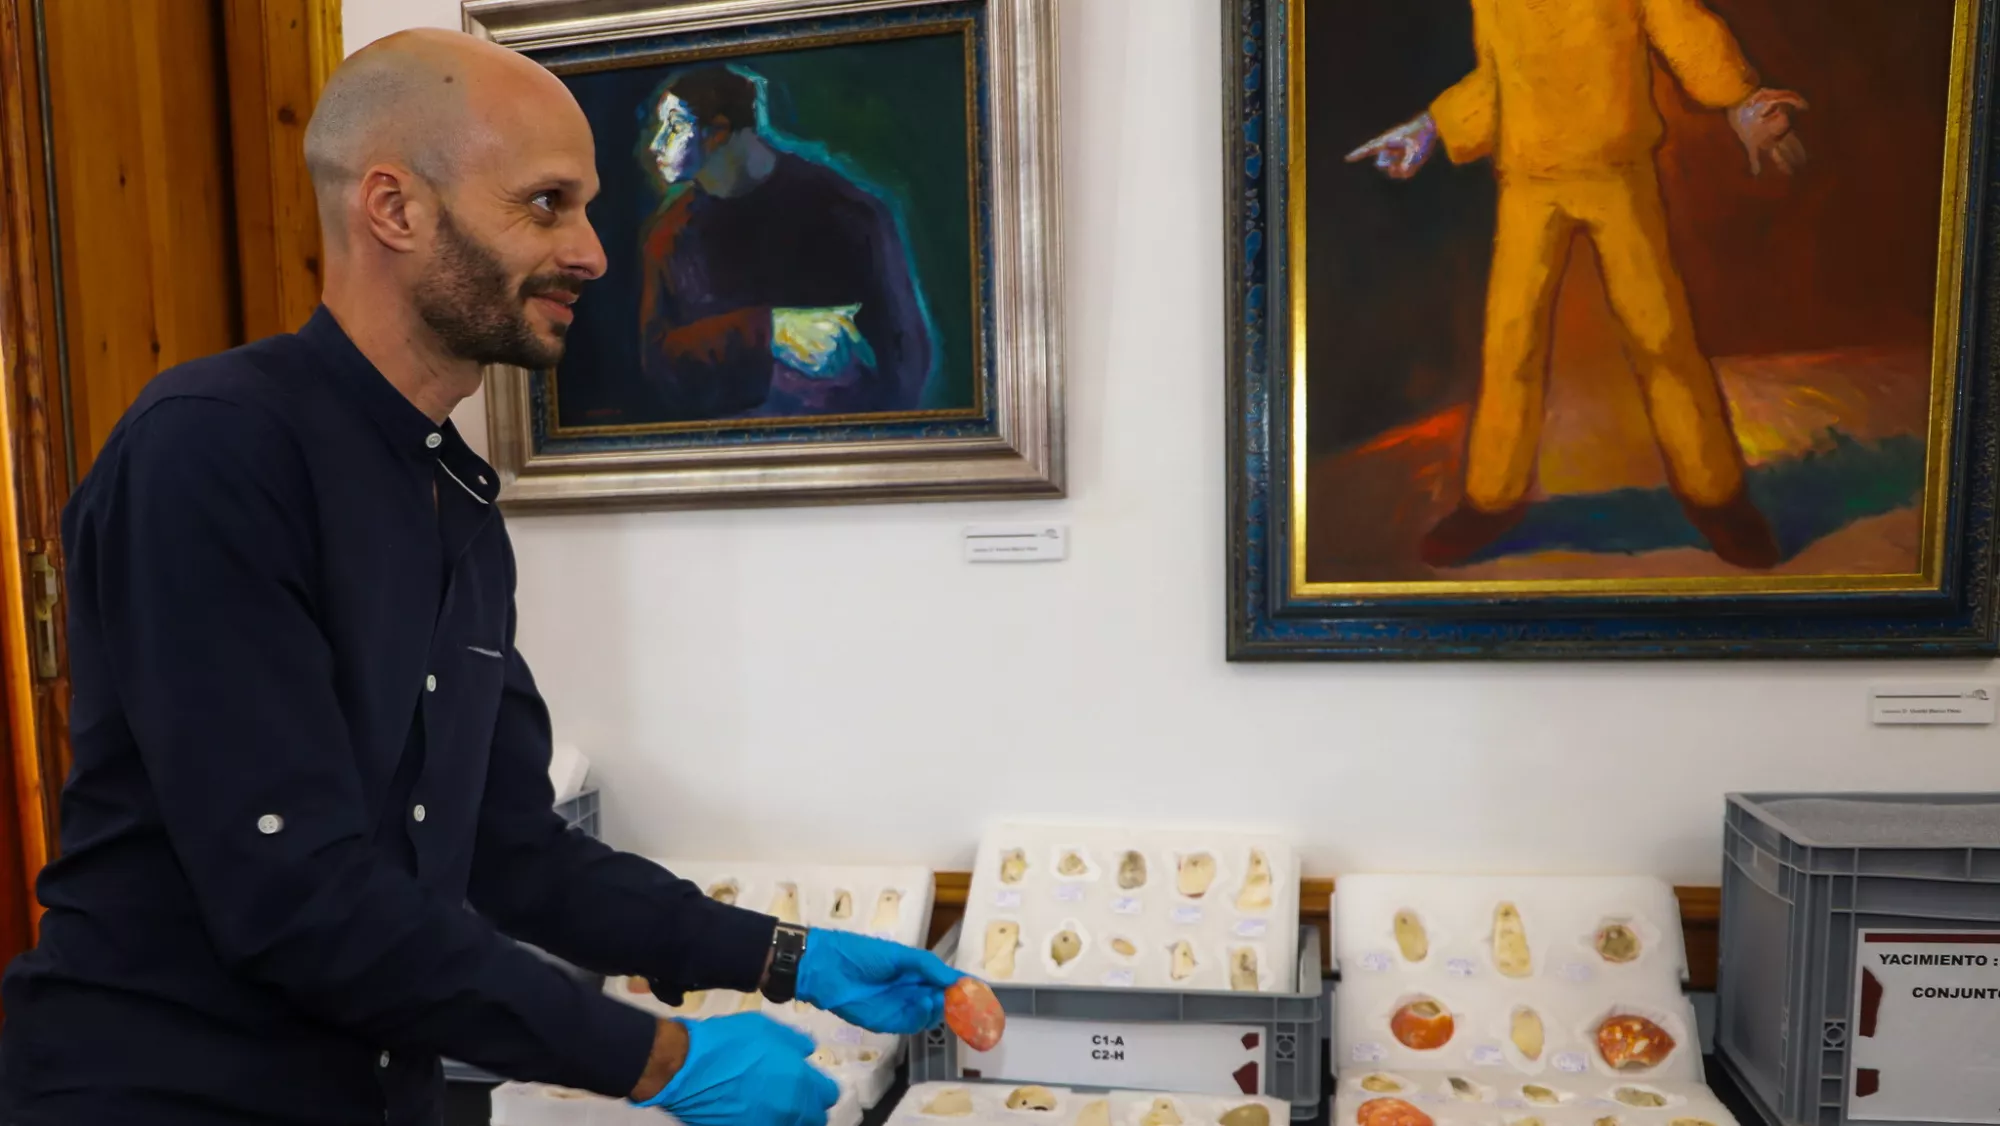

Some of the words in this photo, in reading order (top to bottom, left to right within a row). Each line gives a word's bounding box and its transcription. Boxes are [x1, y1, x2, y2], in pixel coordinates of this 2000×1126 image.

[1879, 954, 1988, 966] YACIMIENTO
[1912, 987, 2000, 999] CONJUNT
[1092, 1035, 1124, 1046] C1-A
[1091, 1050, 1125, 1060] C2-H
